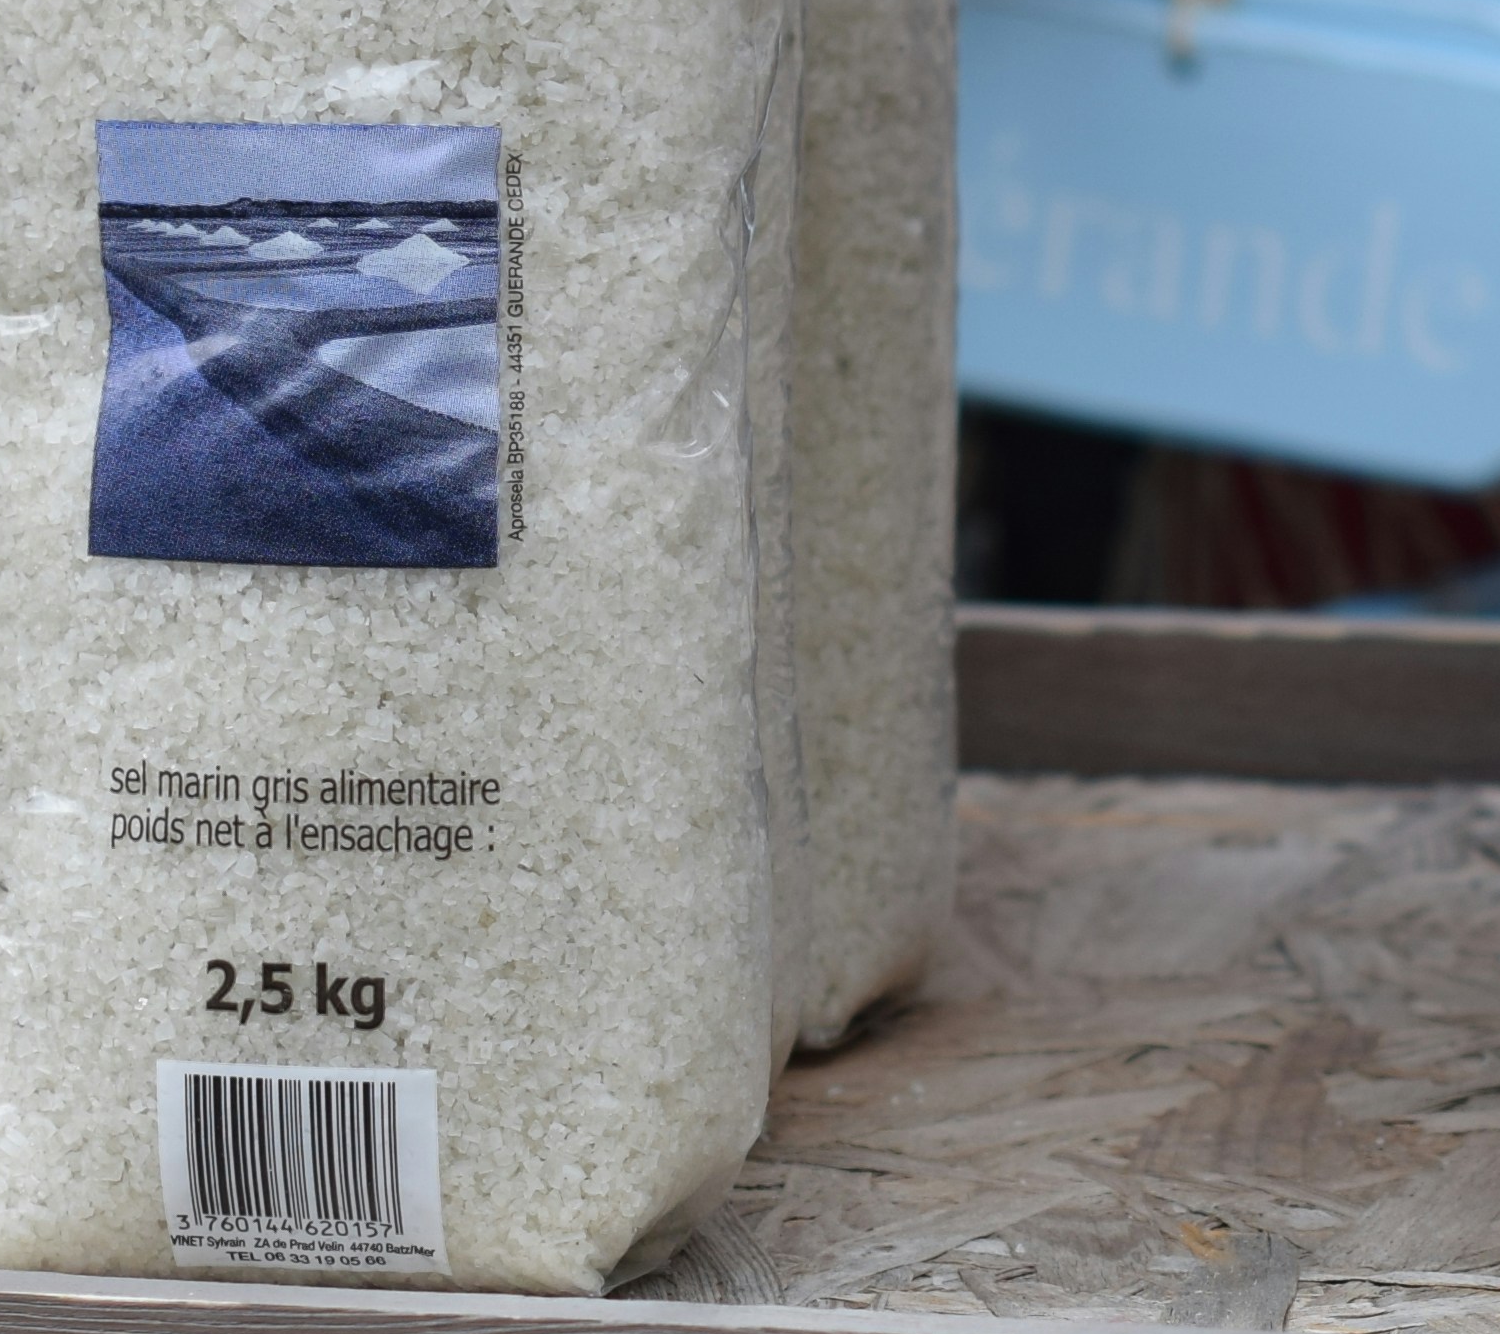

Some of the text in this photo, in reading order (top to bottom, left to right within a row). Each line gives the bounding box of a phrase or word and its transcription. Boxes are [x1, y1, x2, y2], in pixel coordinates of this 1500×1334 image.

[955, 127, 1495, 382] érande
[507, 153, 524, 542] Aprosela BP35188 44351 GUERANDE CEDEX
[109, 760, 501, 810] sel marin gris alimentaire
[111, 808, 472, 860] poids net à l'ensachage
[205, 959, 386, 1029] 2,5 kg
[171, 1235, 204, 1247] VINET
[207, 1236, 245, 1249] Sylvain
[254, 1238, 270, 1248] ZA
[273, 1238, 287, 1249] de
[318, 1241, 344, 1252] Velin
[350, 1242, 383, 1254] 44740
[176, 1215, 393, 1238] 3 760144 620157
[226, 1251, 387, 1266] TEL 06 33 19 05 66
